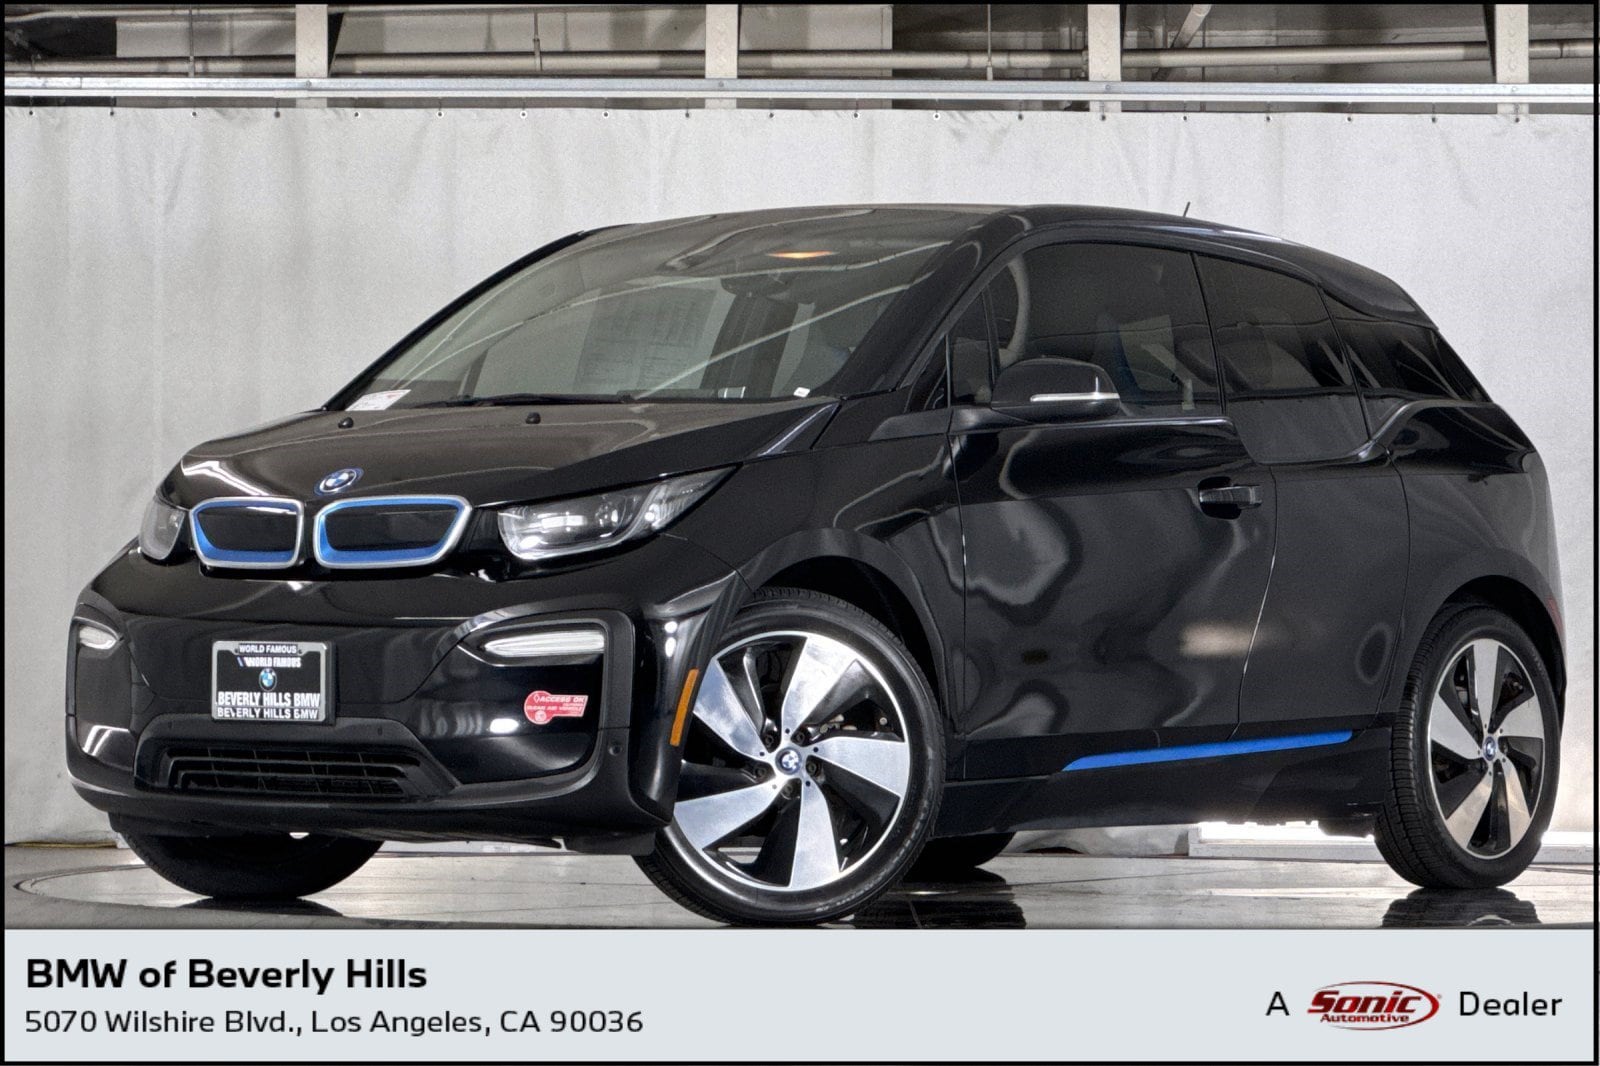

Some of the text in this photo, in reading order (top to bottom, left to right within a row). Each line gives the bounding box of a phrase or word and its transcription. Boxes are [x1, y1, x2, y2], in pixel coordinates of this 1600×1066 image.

[239, 644, 297, 654] WORLD FAMOUS
[243, 657, 301, 668] WORLD FAMOUS
[218, 691, 320, 707] BEVERLY HILLS BMW
[264, 708, 291, 719] HILLS
